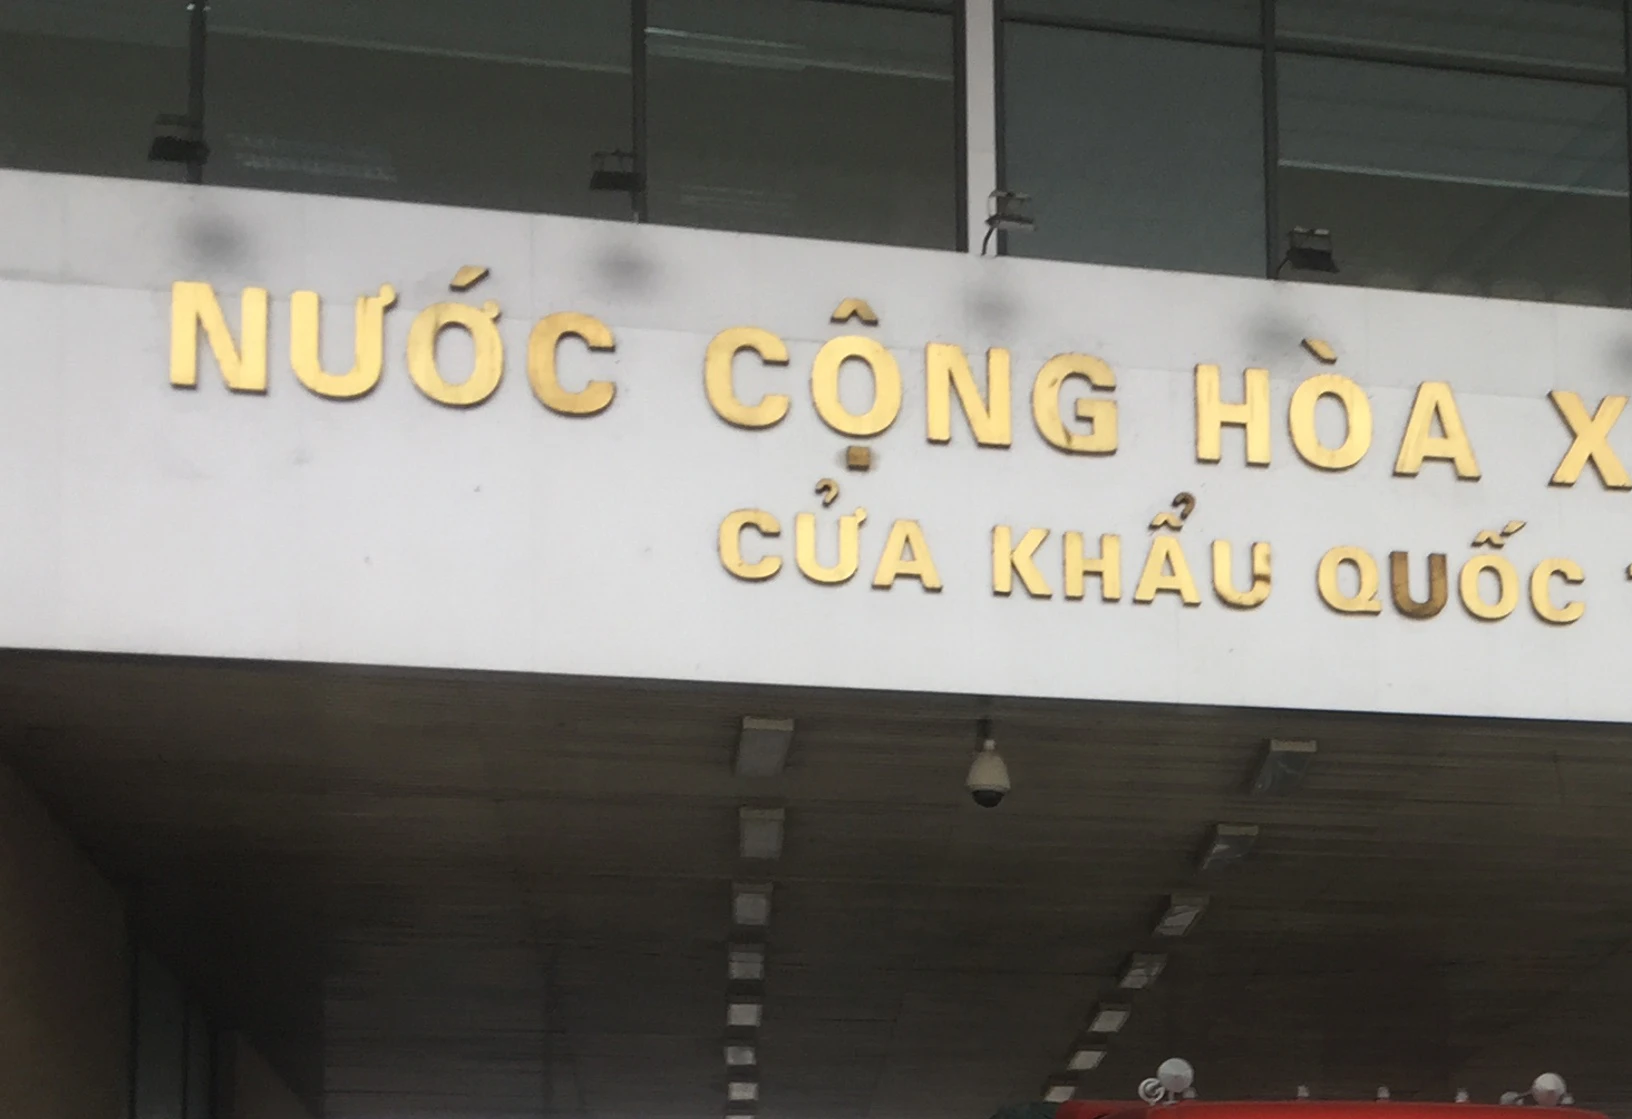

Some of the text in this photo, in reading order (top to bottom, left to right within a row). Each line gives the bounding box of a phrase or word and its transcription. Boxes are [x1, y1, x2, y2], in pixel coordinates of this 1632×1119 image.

[169, 264, 617, 416] NƯỚC
[703, 297, 1119, 471] CỘNG
[1193, 338, 1482, 480] HÒA
[717, 477, 945, 594] CỬA
[990, 492, 1273, 608] KHẨU
[1315, 520, 1587, 626] QUỐC
